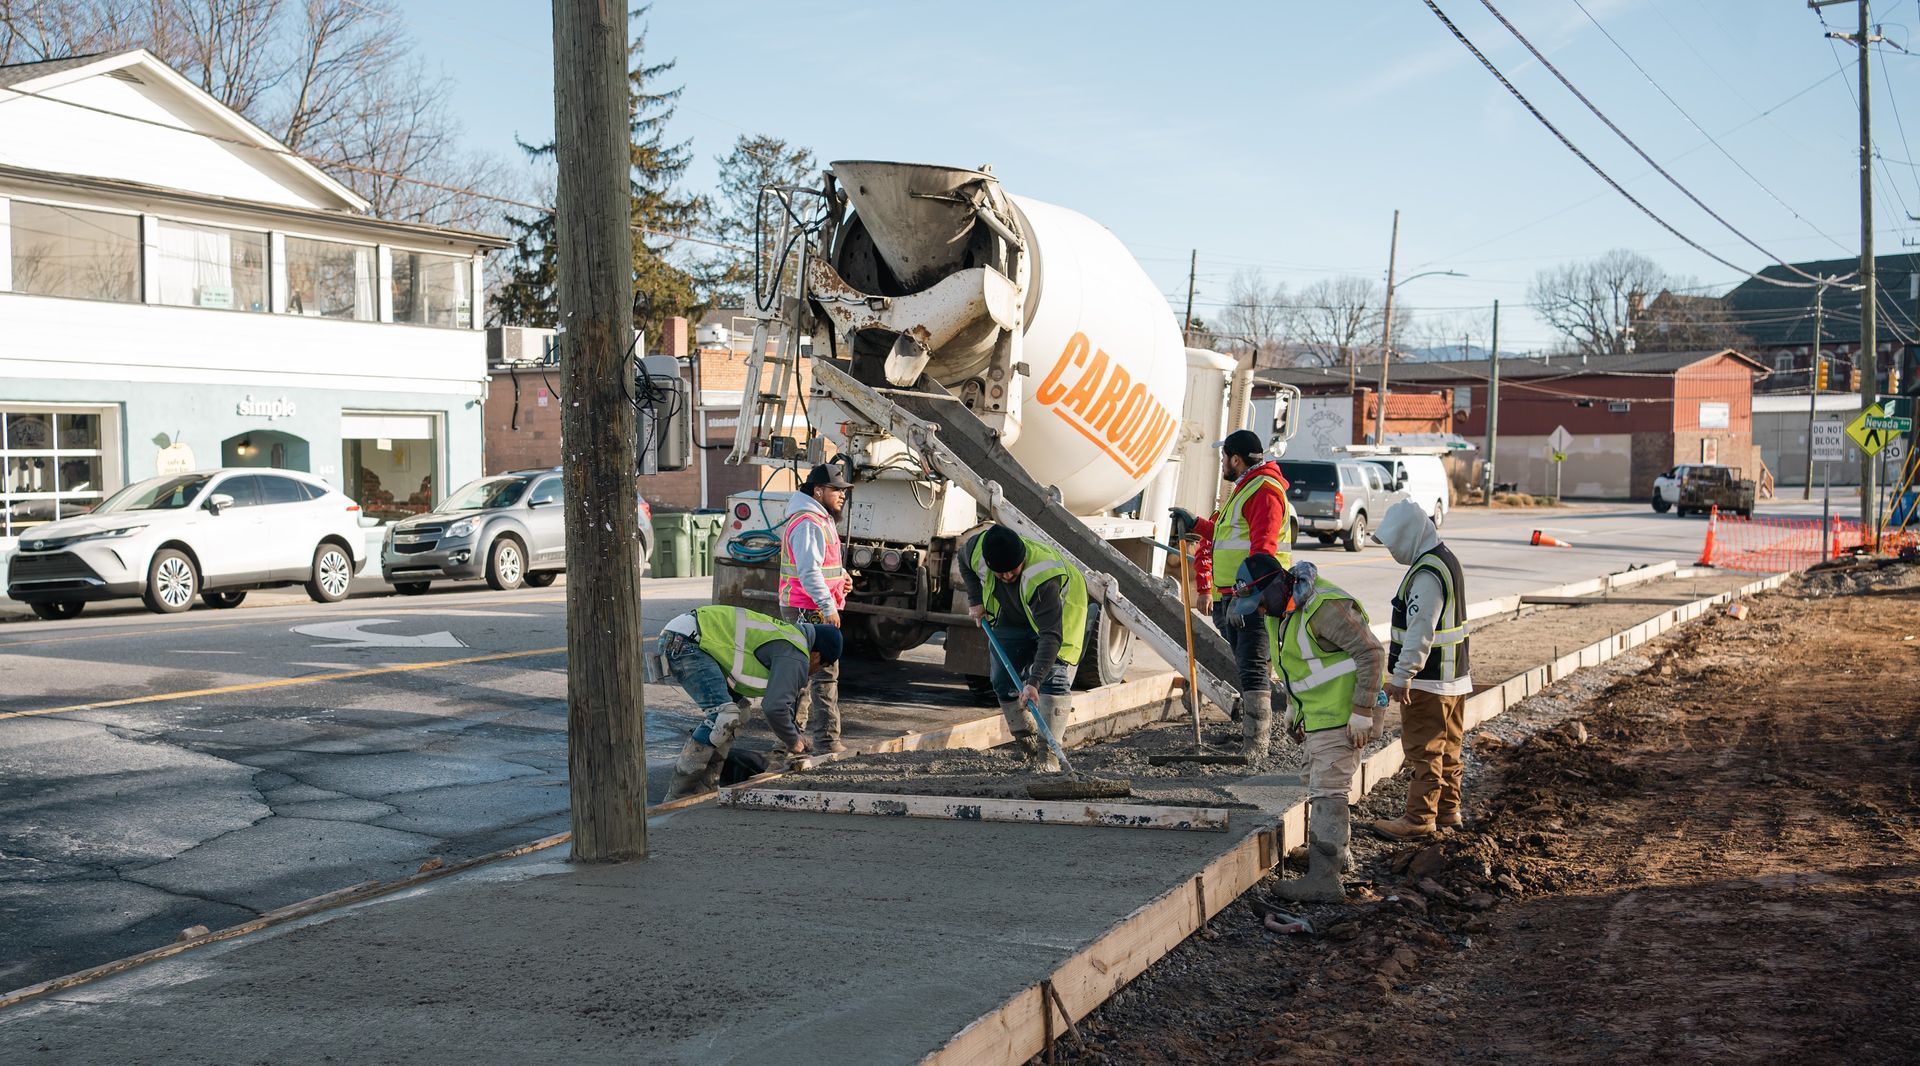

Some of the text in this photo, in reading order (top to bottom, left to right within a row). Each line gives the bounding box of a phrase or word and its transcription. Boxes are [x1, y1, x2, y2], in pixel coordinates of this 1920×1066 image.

[237, 394, 296, 421] simple
[1866, 416, 1899, 429] Nevada
[1813, 425, 1842, 434] DO NOT
[1815, 436, 1840, 445] BLOCK
